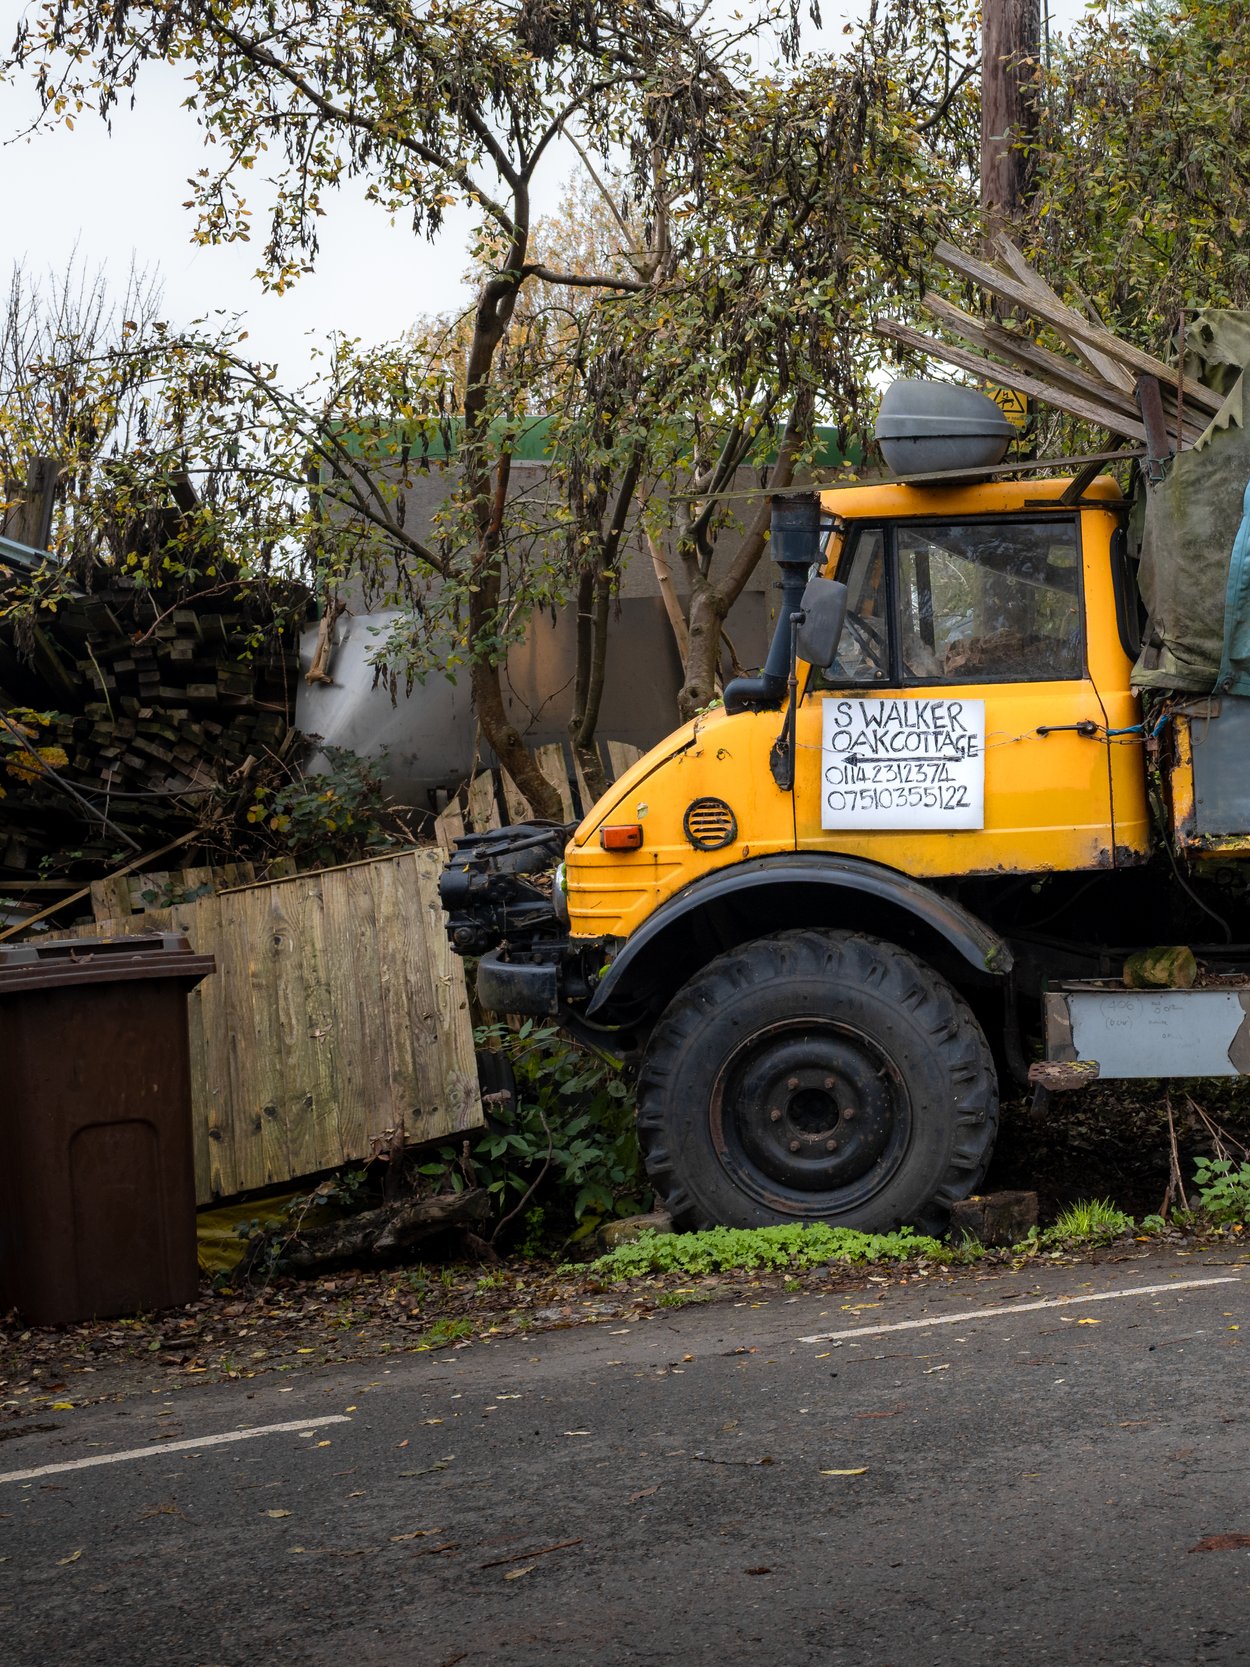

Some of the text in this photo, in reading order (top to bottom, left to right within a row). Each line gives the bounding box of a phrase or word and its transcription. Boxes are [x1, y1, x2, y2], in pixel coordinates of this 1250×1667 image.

[834, 700, 968, 732] S WALKER
[827, 785, 971, 811] 07510355122
